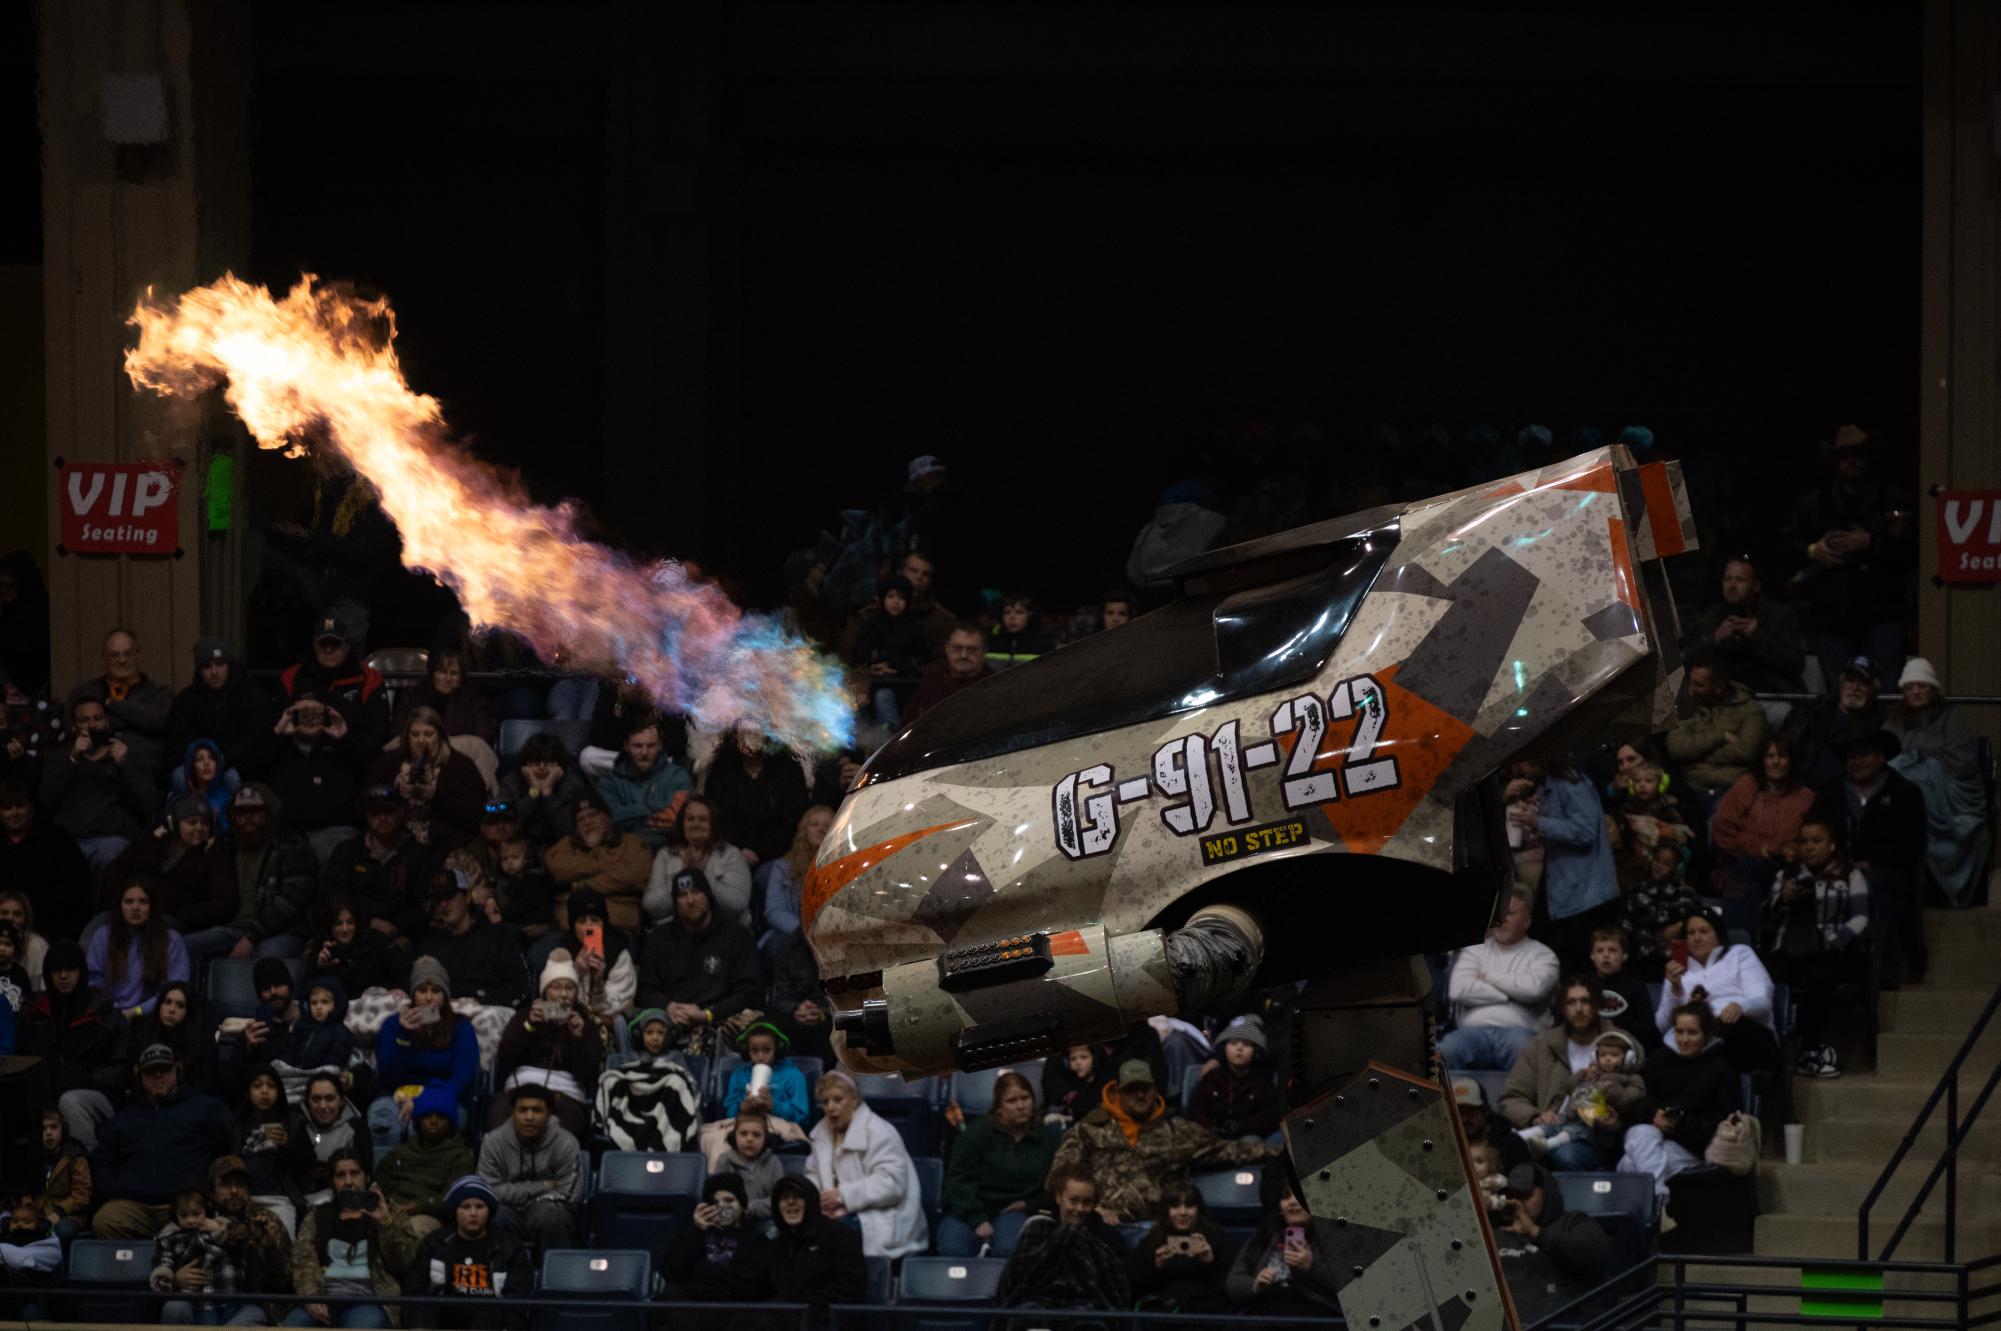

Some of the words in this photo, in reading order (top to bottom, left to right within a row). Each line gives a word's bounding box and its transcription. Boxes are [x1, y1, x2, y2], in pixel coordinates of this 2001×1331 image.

[67, 470, 171, 516] VIP
[81, 523, 158, 544] Seating
[1052, 673, 1400, 861] G-91-22
[1205, 836, 1239, 860] NO
[1245, 822, 1304, 851] STEP
